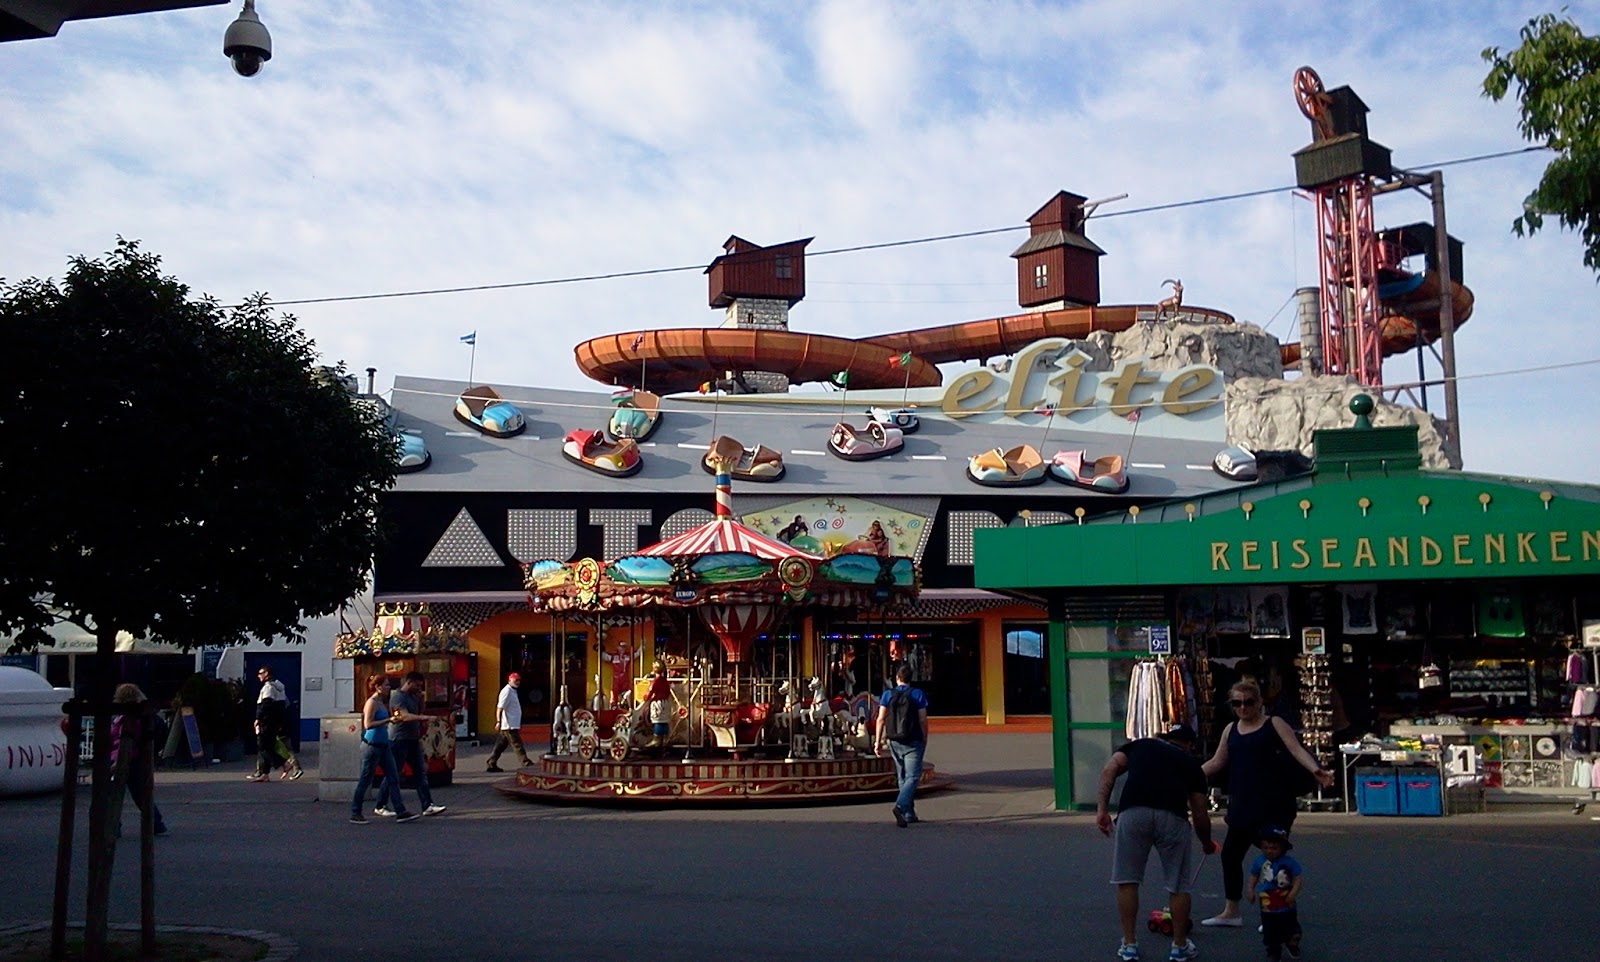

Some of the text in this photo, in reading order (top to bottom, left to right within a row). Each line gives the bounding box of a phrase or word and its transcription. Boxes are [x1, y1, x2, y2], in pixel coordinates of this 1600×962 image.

[941, 340, 1221, 419] elite
[1211, 530, 1600, 571] REISEANDENKEN
[7, 743, 67, 770] INI-D
[1457, 749, 1469, 773] 1
